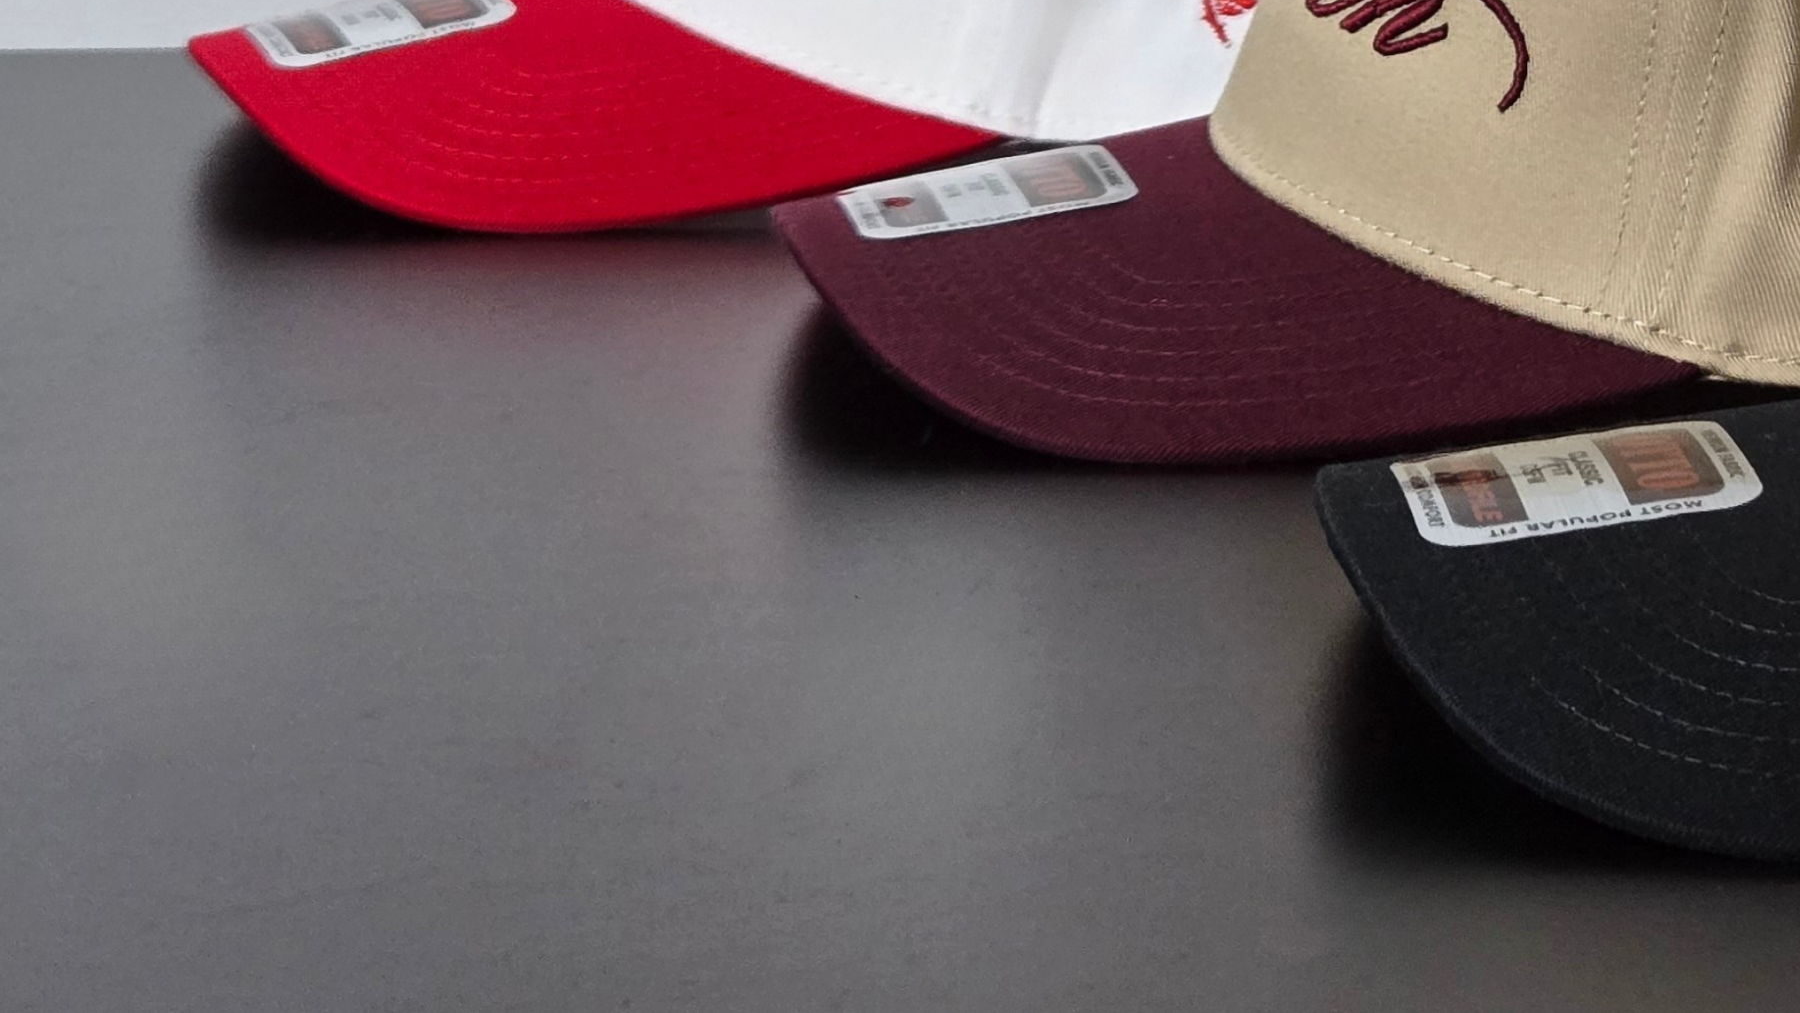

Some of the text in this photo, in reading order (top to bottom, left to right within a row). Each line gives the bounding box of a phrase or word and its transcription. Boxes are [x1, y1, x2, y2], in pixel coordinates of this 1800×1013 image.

[1568, 450, 1605, 486] CLASSIC
[1489, 499, 1703, 538] MOST POPULAR FIT
